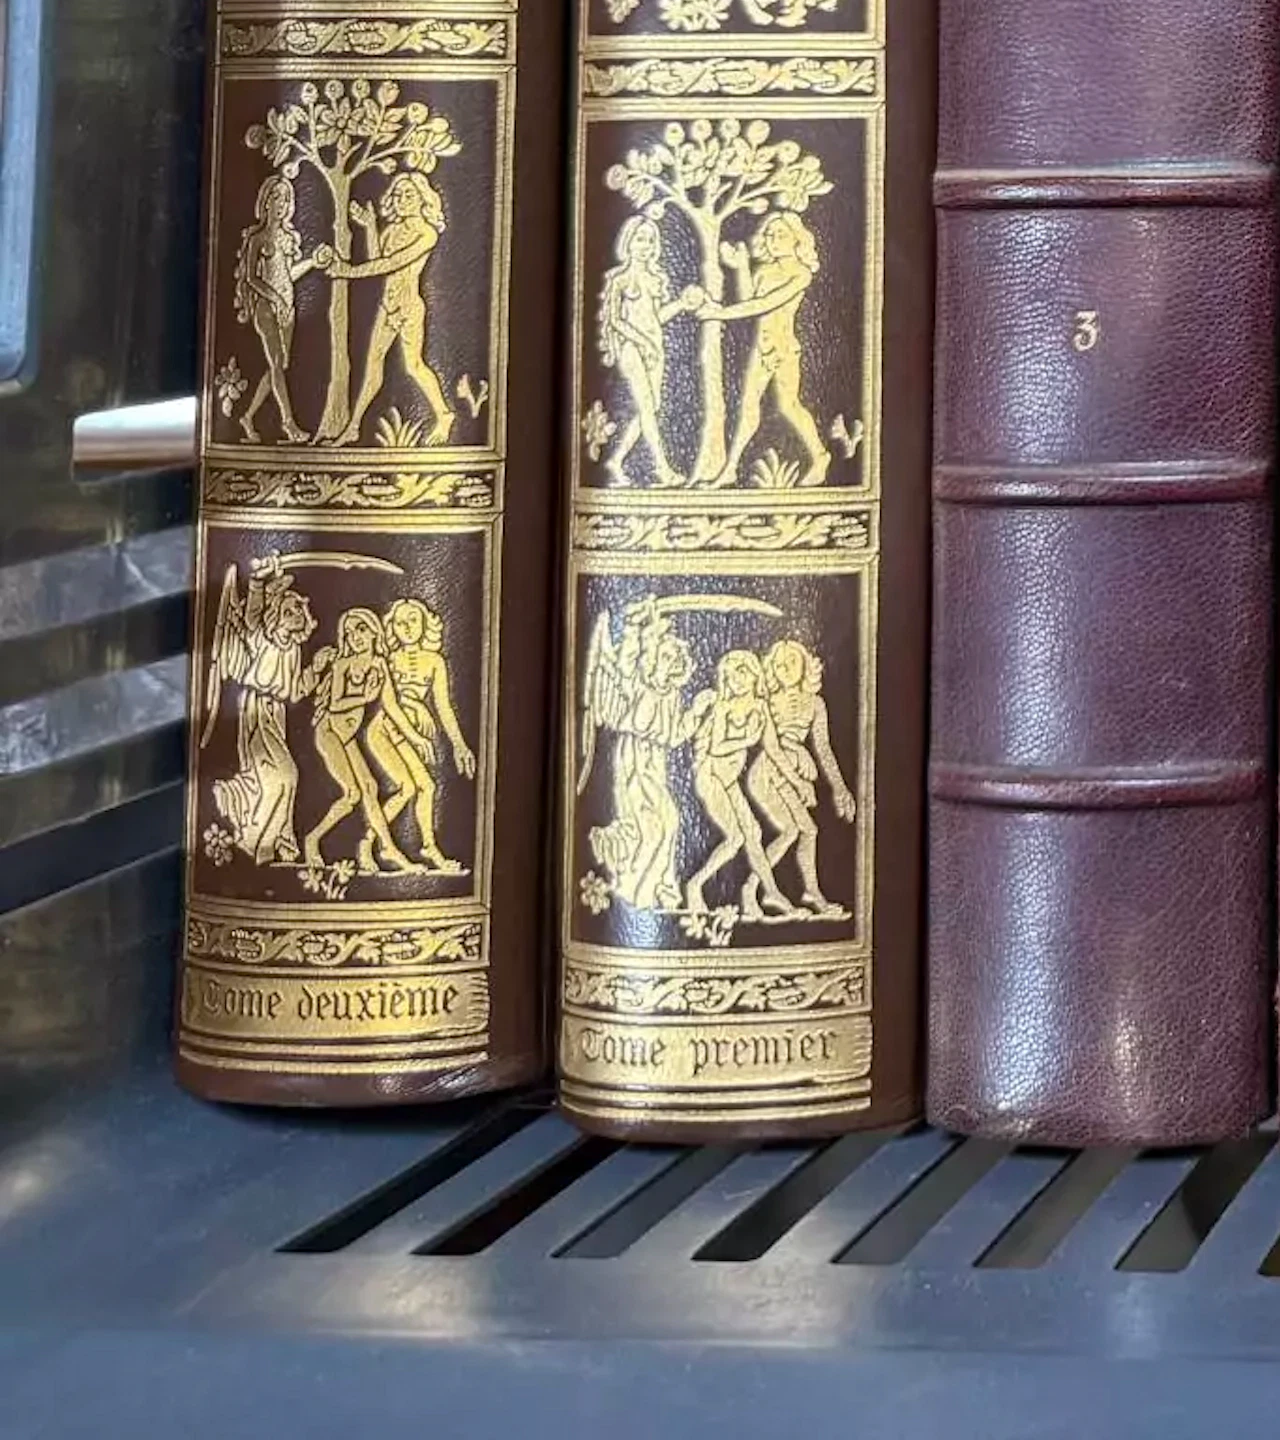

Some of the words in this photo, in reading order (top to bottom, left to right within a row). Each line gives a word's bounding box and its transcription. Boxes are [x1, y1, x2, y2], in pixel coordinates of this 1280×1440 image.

[1071, 310, 1103, 351] 3
[203, 978, 283, 1020] Tome
[579, 1031, 665, 1069] Tome
[690, 1028, 839, 1076] premier
